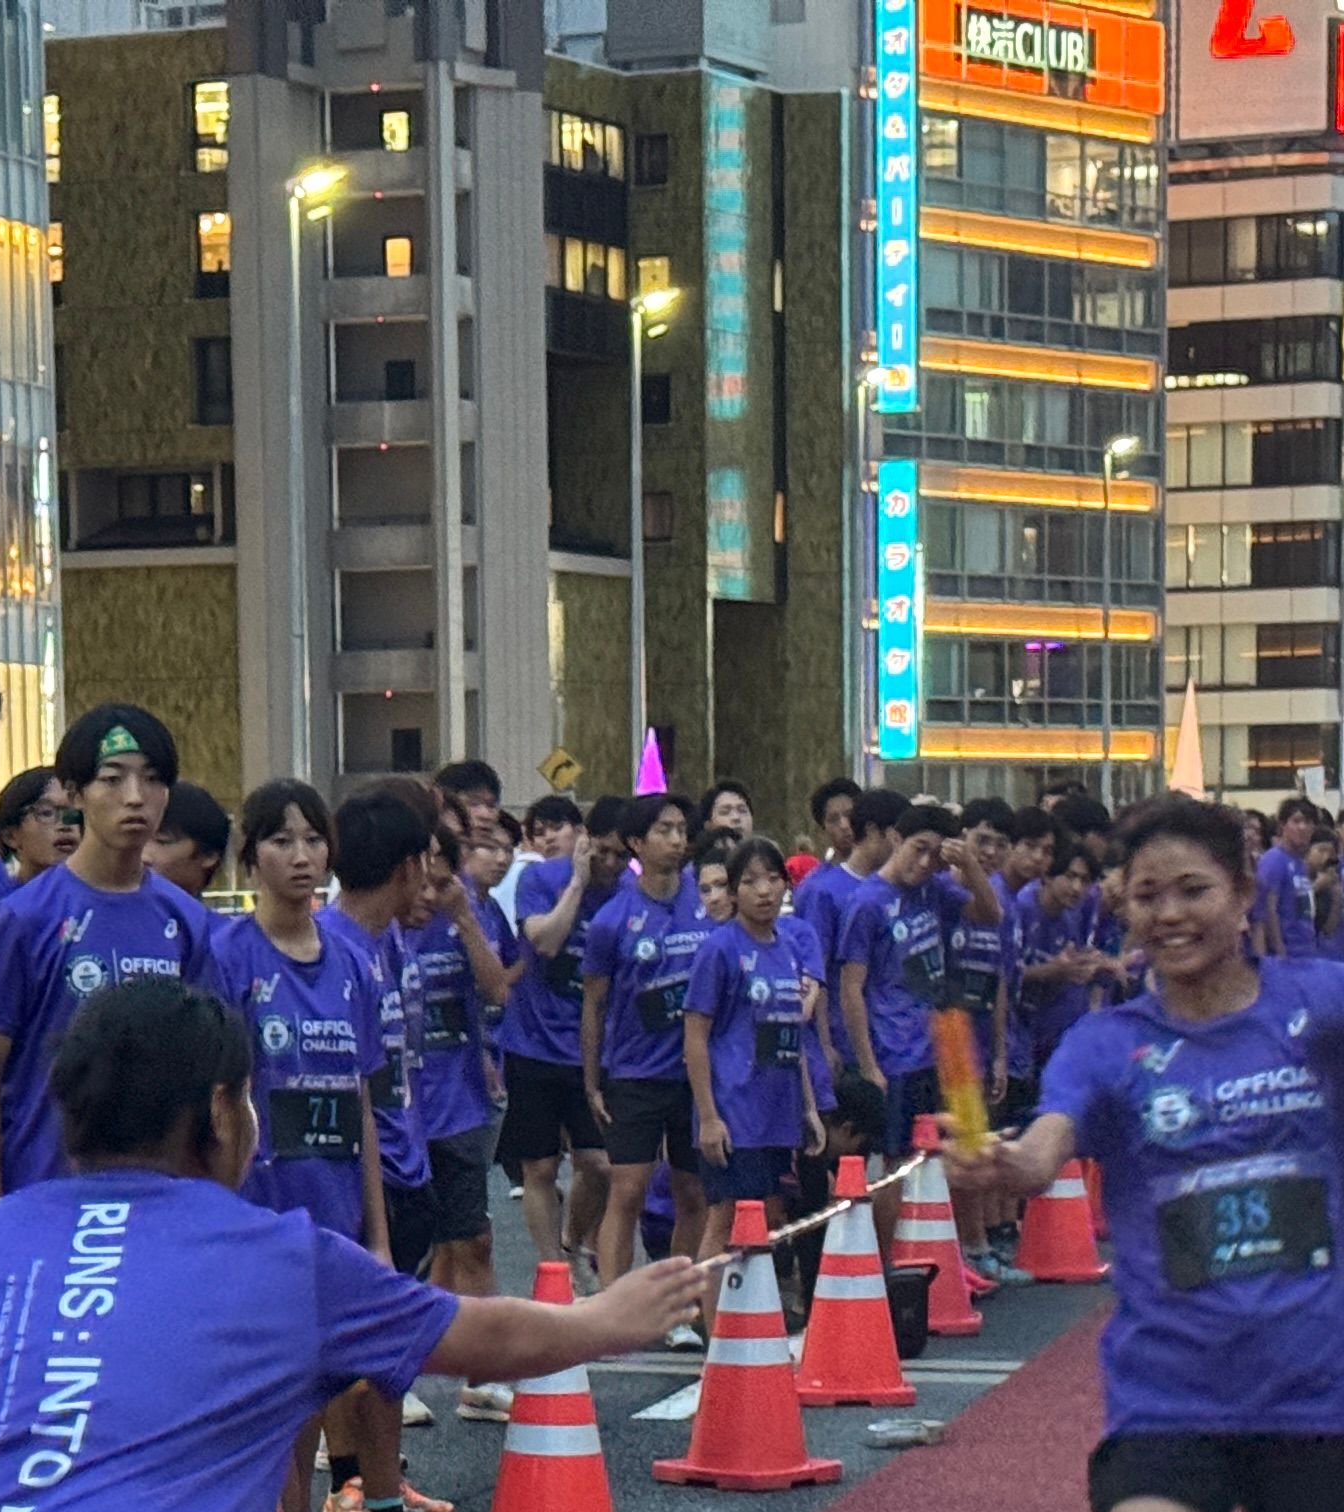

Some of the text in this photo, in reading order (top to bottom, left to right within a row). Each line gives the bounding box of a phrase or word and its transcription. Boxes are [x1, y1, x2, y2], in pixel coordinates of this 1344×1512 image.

[885, 489, 913, 733] カラオケ館
[308, 1096, 338, 1128] 71
[58, 1202, 130, 1318] RUNS
